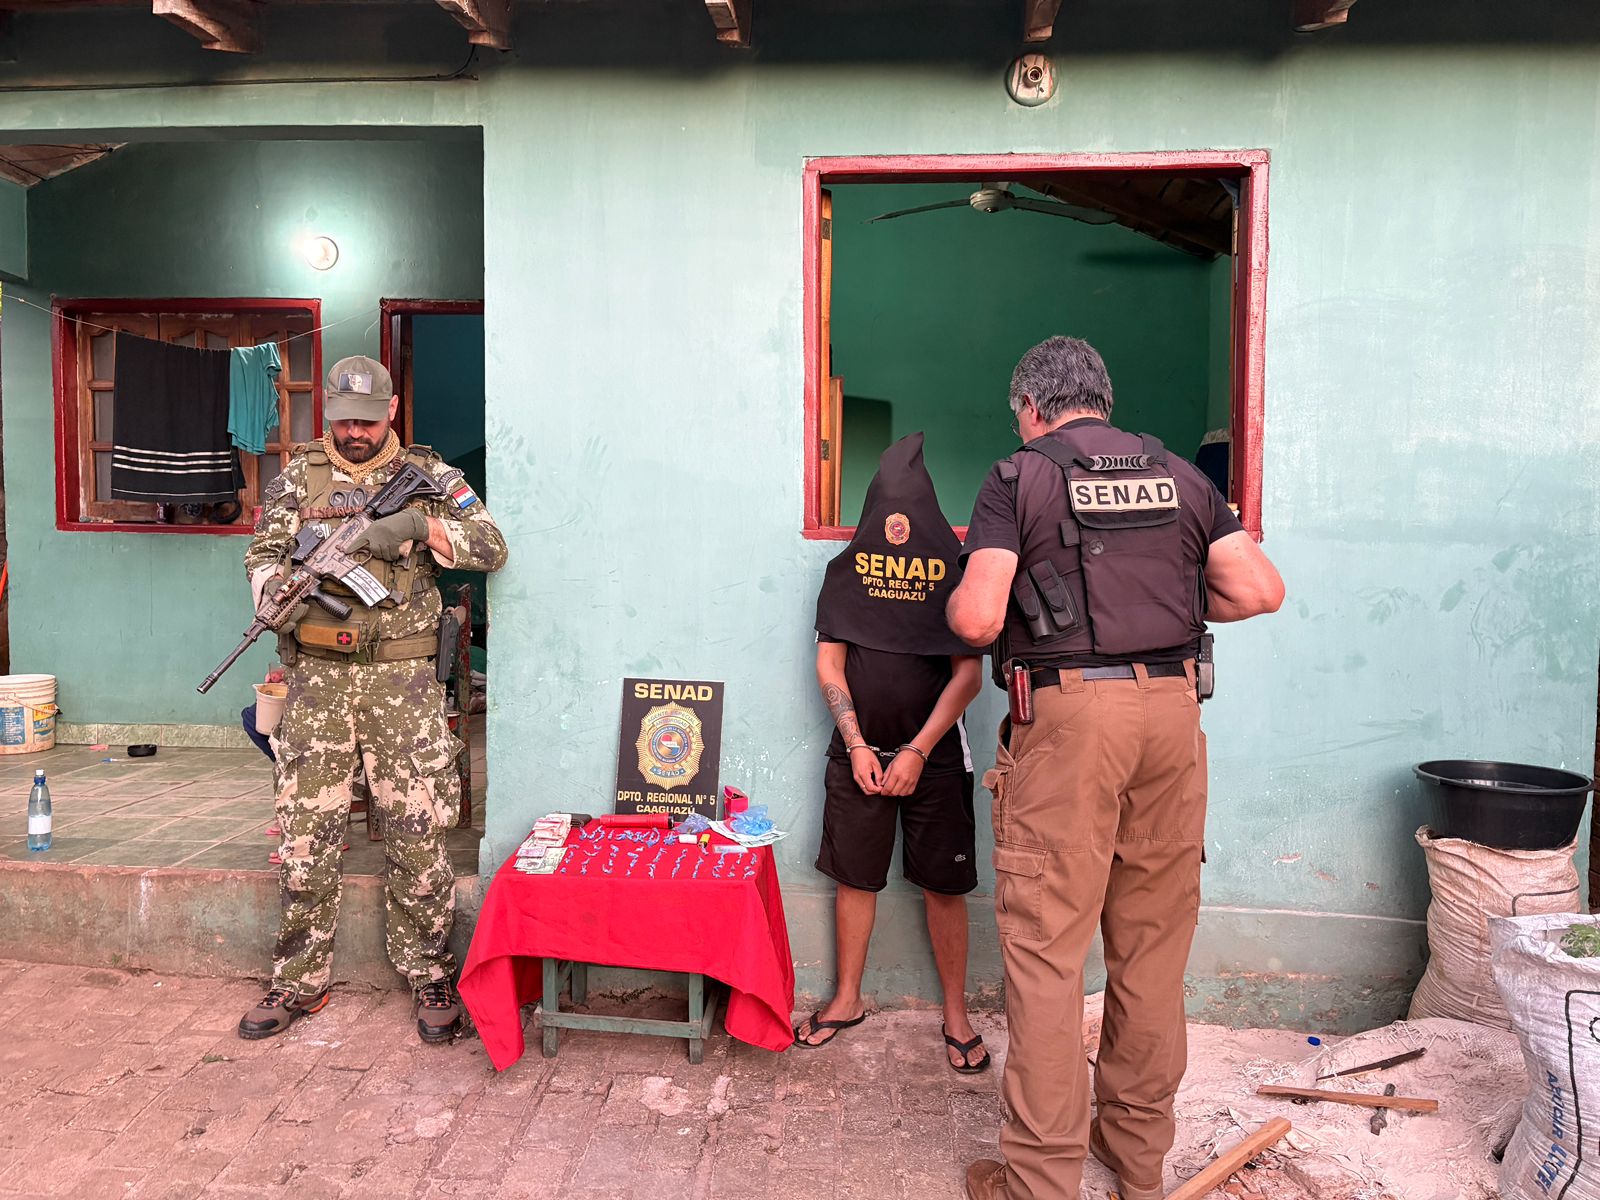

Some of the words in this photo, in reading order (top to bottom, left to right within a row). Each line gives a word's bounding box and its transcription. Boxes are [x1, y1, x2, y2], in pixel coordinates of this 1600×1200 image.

[1075, 482, 1174, 505] SENAD
[855, 552, 946, 581] SENAD
[862, 576, 886, 588] DPTO.
[888, 579, 912, 590] REG.
[928, 582, 935, 591] 5
[634, 683, 713, 701] SENAD
[617, 790, 644, 802] DPTO.
[646, 791, 693, 805] REGIONAL
[709, 795, 716, 806] 5
